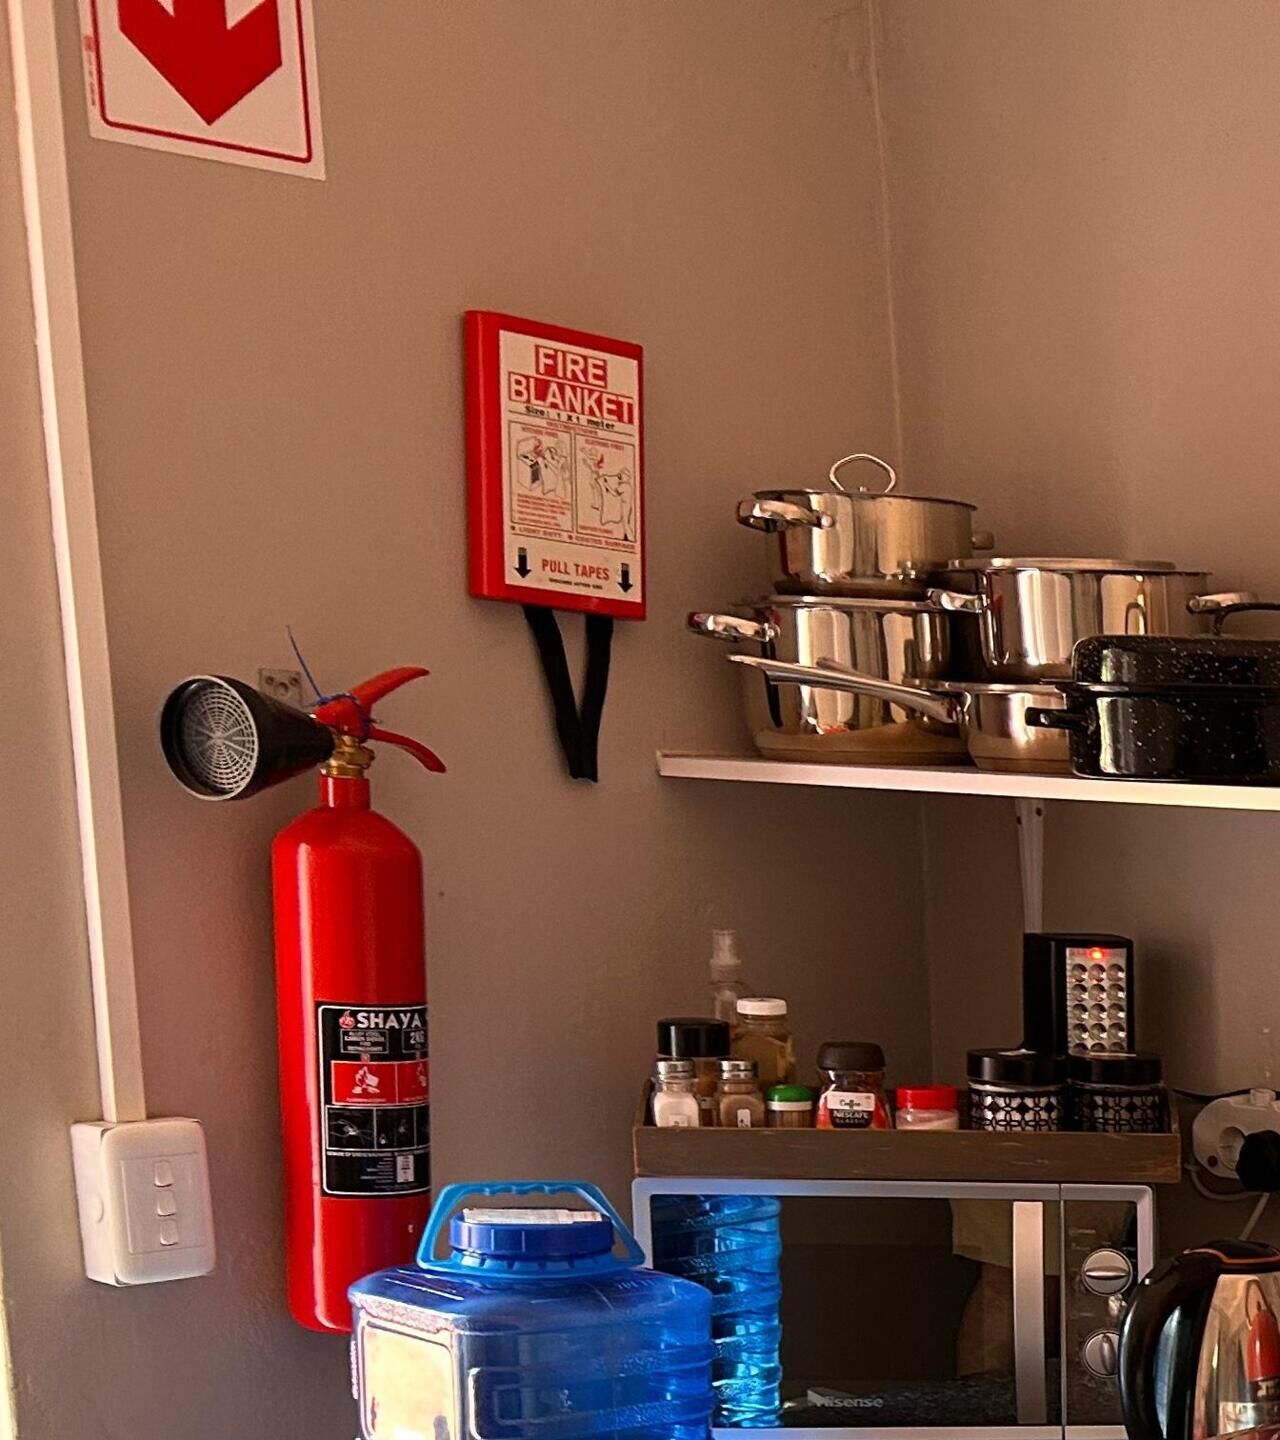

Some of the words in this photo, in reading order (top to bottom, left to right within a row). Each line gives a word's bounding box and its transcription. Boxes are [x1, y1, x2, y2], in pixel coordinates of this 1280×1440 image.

[538, 347, 606, 387] FIRE
[510, 373, 634, 424] BLANKET
[587, 418, 615, 430] meter
[541, 558, 571, 575] PULL
[573, 563, 610, 581] TAPES
[356, 1011, 422, 1030] SHAYA
